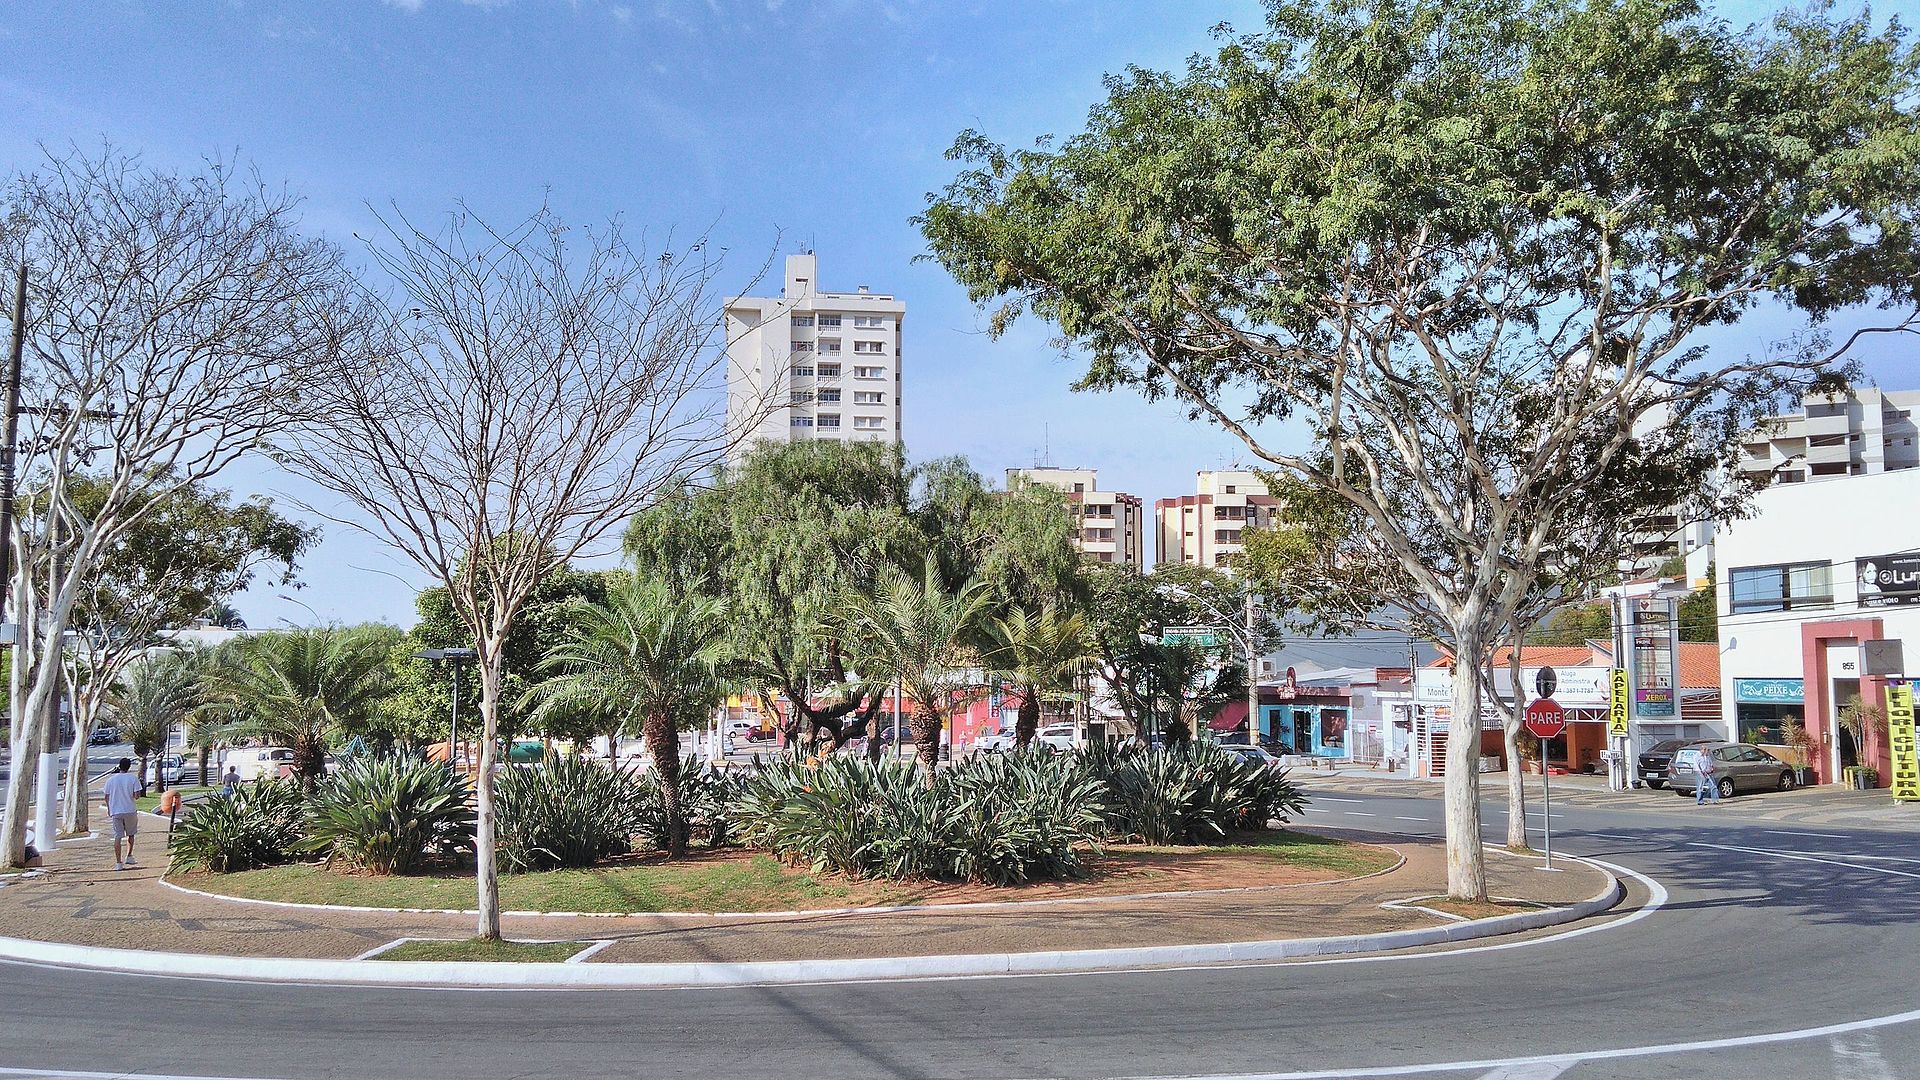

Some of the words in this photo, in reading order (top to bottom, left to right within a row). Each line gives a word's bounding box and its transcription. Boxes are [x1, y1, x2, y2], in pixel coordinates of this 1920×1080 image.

[1842, 662, 1854, 670] 855
[1427, 688, 1449, 696] Monte
[1763, 686, 1788, 695] PEIXE
[1613, 669, 1625, 731] PAPELARIA
[1646, 693, 1668, 701] XEROX
[1530, 711, 1561, 725] PARE
[1890, 692, 1919, 797] FLORICULTURA
